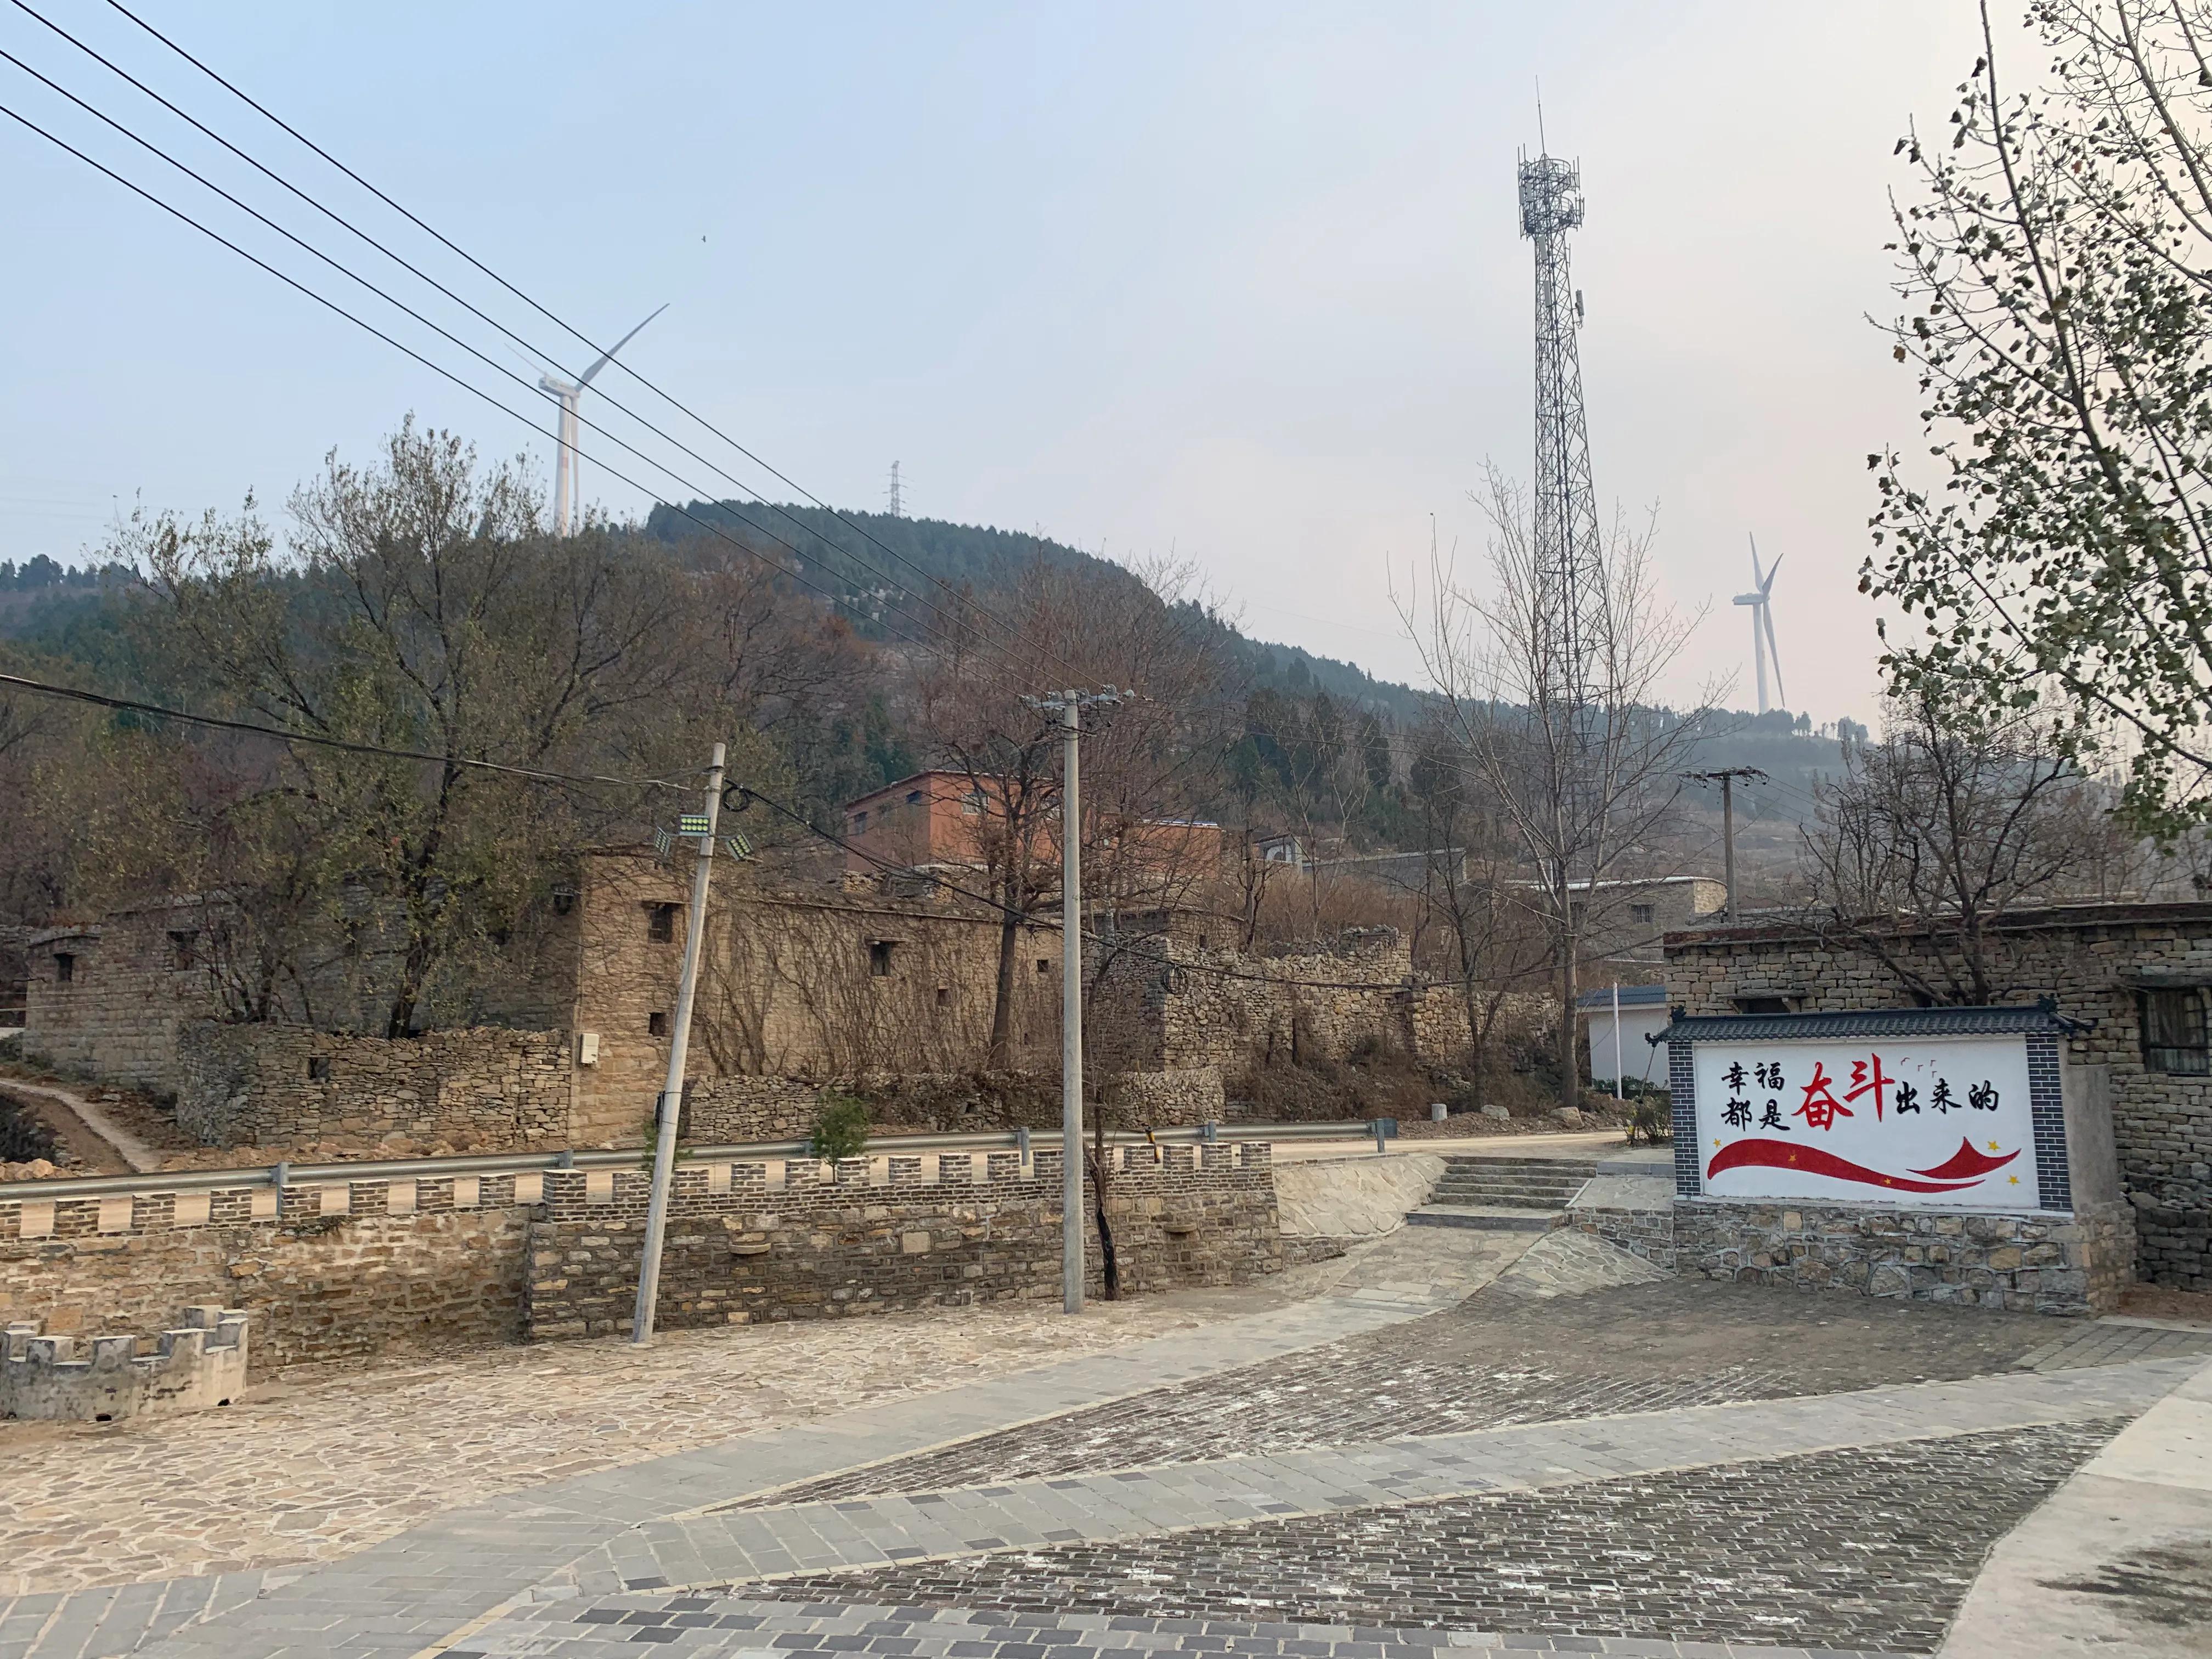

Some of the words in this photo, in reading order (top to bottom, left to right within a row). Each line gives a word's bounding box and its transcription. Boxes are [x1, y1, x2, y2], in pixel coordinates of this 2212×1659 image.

[1720, 1060, 1786, 1096] 幸福
[1791, 1052, 1895, 1132] 奋斗
[1720, 1097, 1791, 1132] 都是
[1895, 1078, 2000, 1115] 出来的
